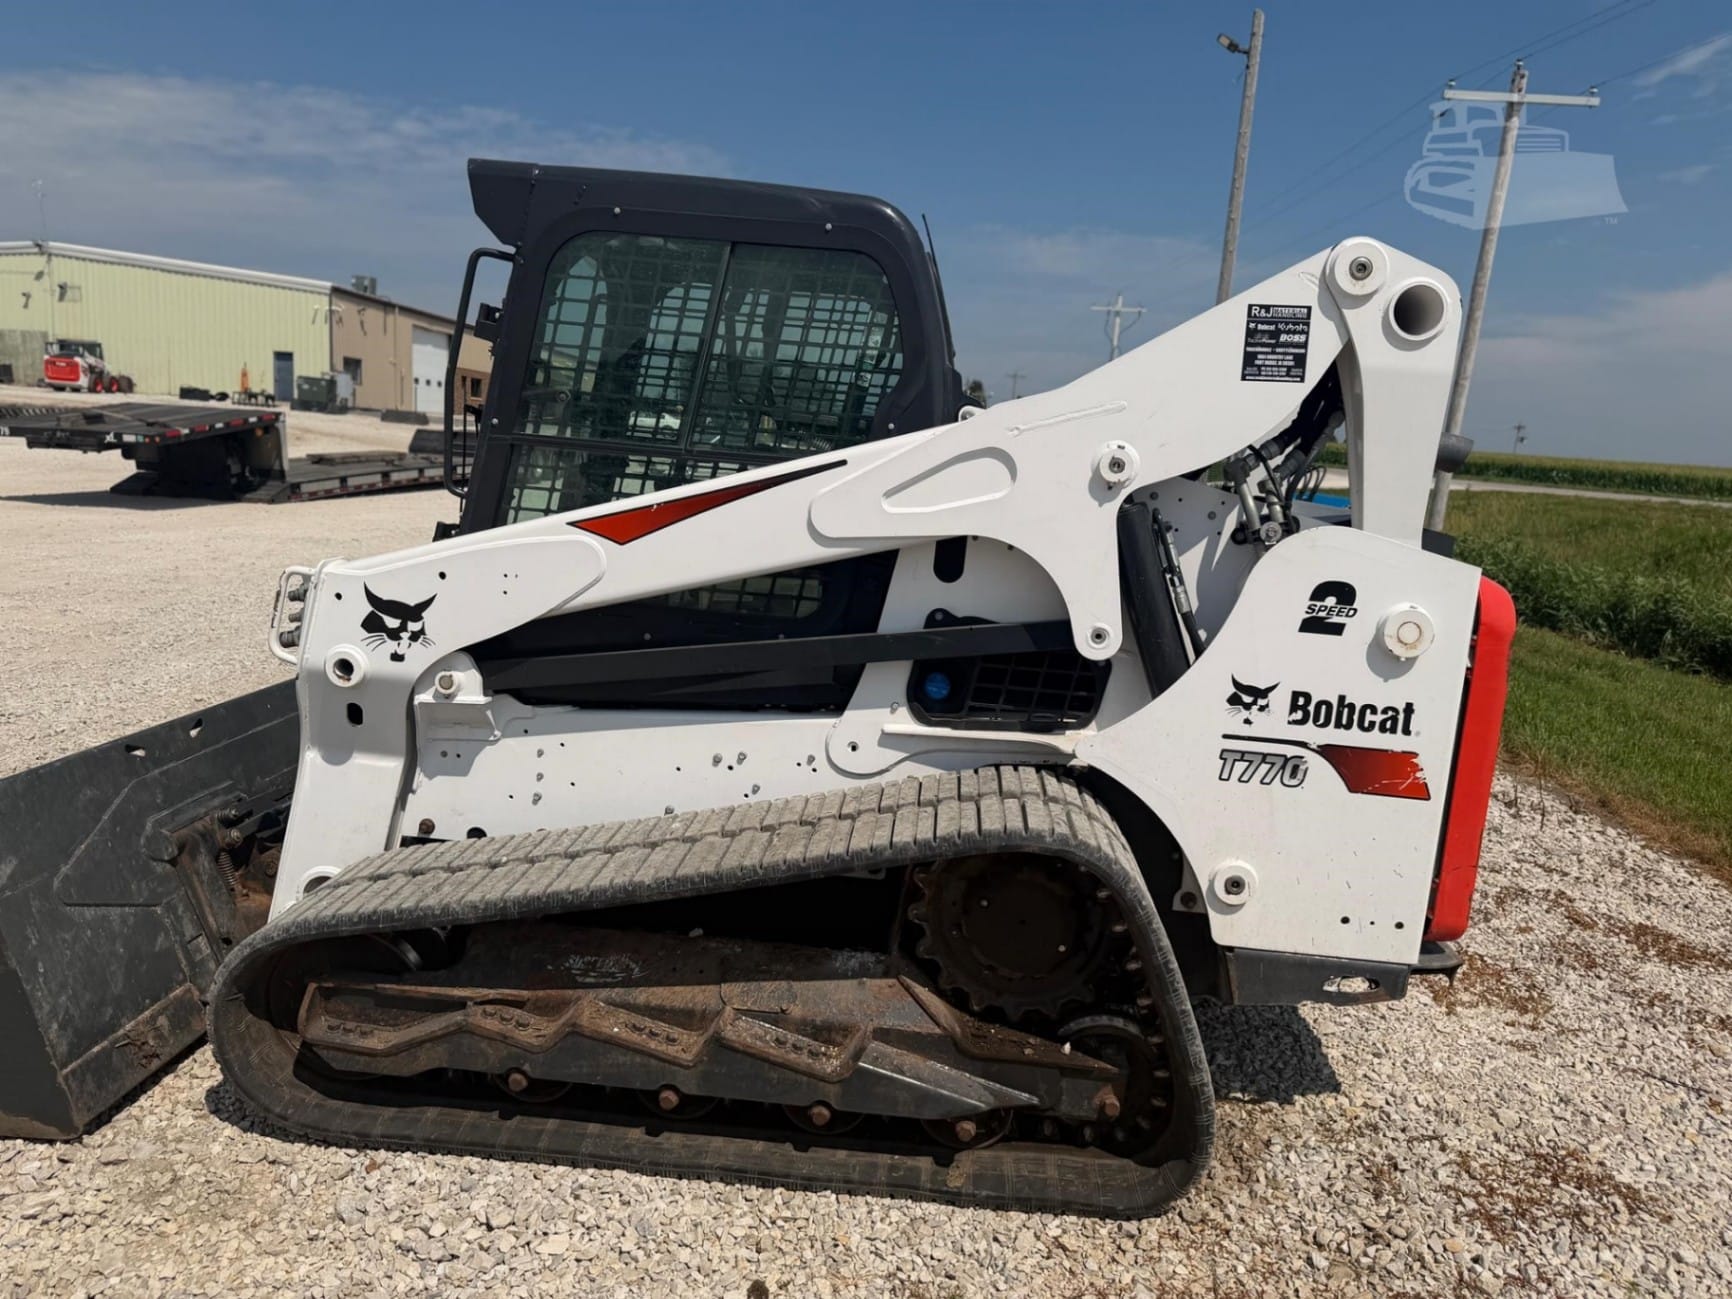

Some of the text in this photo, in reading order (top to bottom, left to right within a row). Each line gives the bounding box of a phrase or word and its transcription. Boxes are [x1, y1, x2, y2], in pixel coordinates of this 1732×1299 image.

[1251, 306, 1273, 318] R&J
[1298, 580, 1357, 636] 2
[1304, 603, 1358, 618] SPEED
[1287, 690, 1415, 736] Bobcat
[1219, 749, 1309, 788] T770
